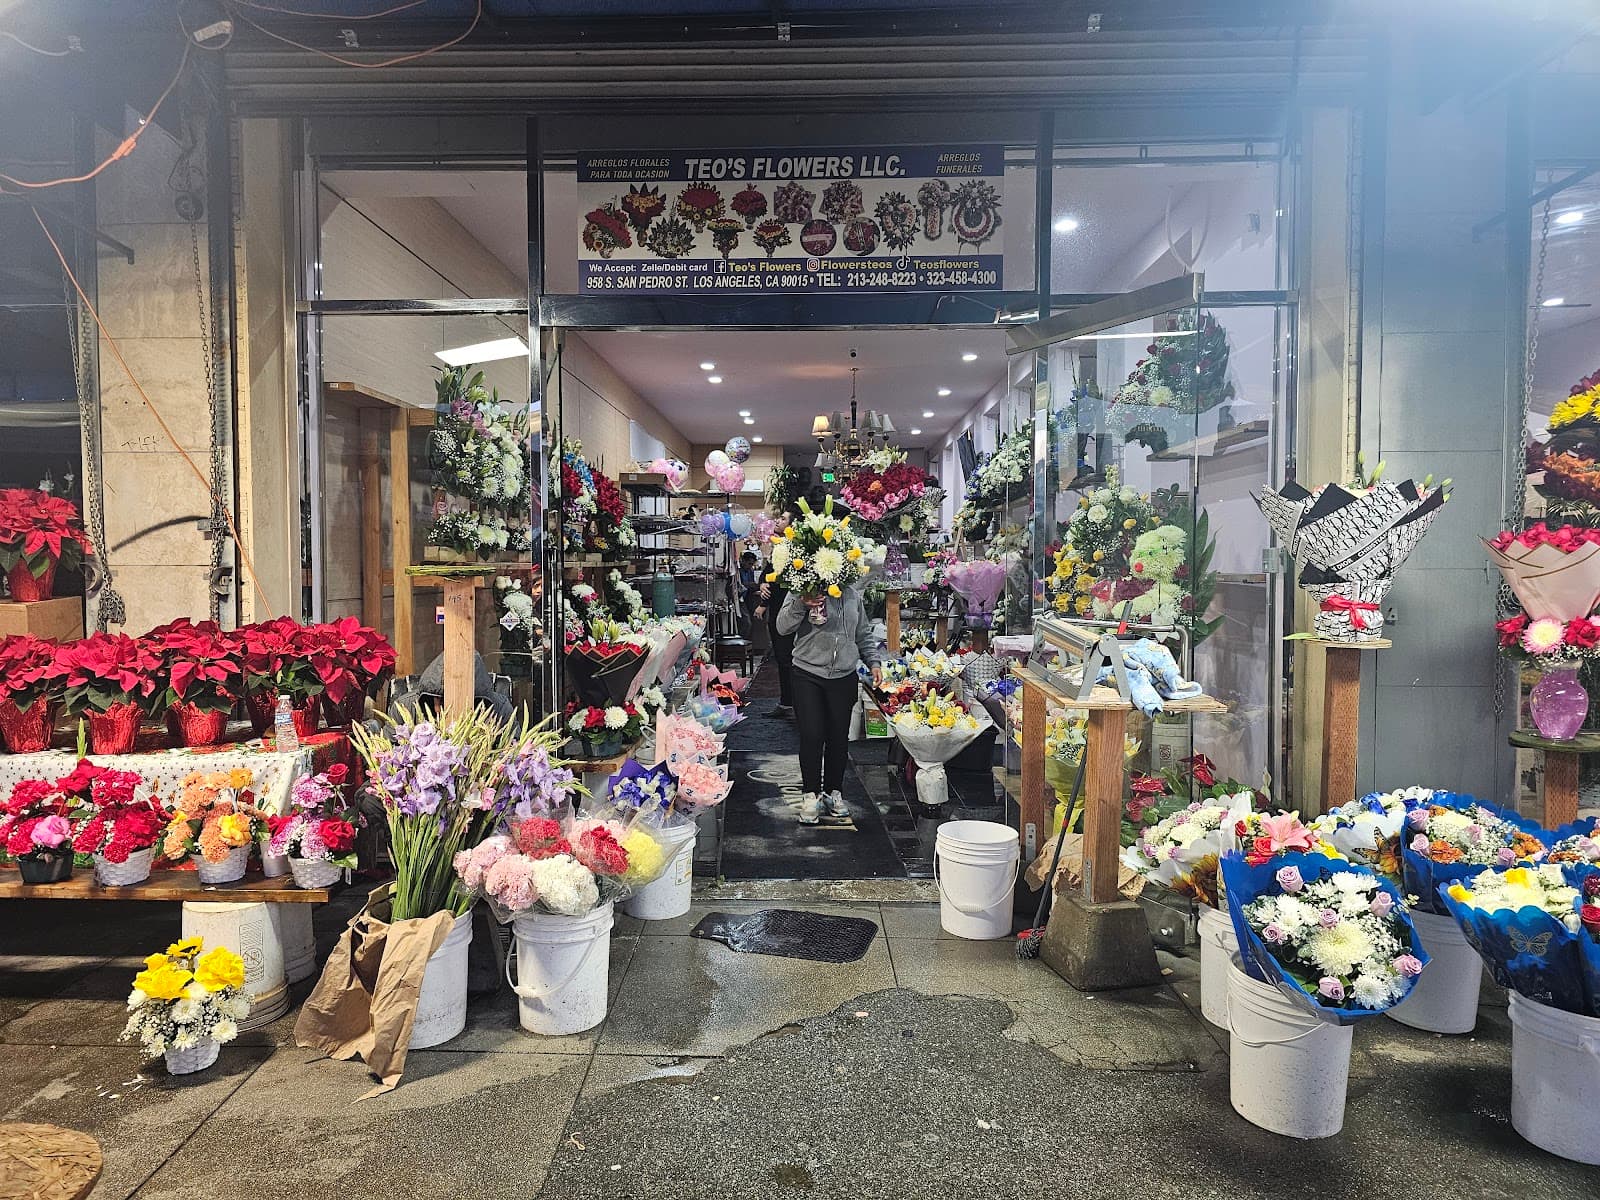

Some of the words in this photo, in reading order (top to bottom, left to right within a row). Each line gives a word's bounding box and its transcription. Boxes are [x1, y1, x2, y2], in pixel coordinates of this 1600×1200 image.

[938, 153, 981, 162] ARREGLOS
[587, 159, 628, 168] ARREGLOS
[630, 158, 670, 167] FLORALES
[684, 157, 746, 179] TEO'S
[752, 156, 854, 178] FLOWERS
[859, 154, 906, 177] LLC.
[590, 170, 611, 179] PARA
[613, 170, 632, 179] TODA
[635, 169, 670, 178] OCASION
[936, 164, 983, 174] FUNERALES
[589, 264, 602, 272] We
[604, 264, 637, 274] Accept:
[641, 263, 687, 272] Zelle/Debit
[688, 263, 708, 272] card
[728, 262, 756, 272] Teo's
[760, 262, 801, 272] Flowers
[821, 260, 893, 271] Flowersteos
[914, 259, 980, 269] Teosflowers
[586, 276, 603, 289] 958
[604, 276, 615, 289] S.
[616, 276, 637, 289] SAN
[638, 276, 673, 289] PEDRO
[674, 275, 689, 288] ST.
[693, 275, 714, 288] LOS
[714, 275, 763, 289] ANGELES,
[765, 274, 779, 287] CA
[780, 274, 808, 287] 90015
[816, 272, 841, 287] TEL:
[847, 272, 916, 287] 213-248-8223
[926, 270, 997, 286] 323-458-4300
